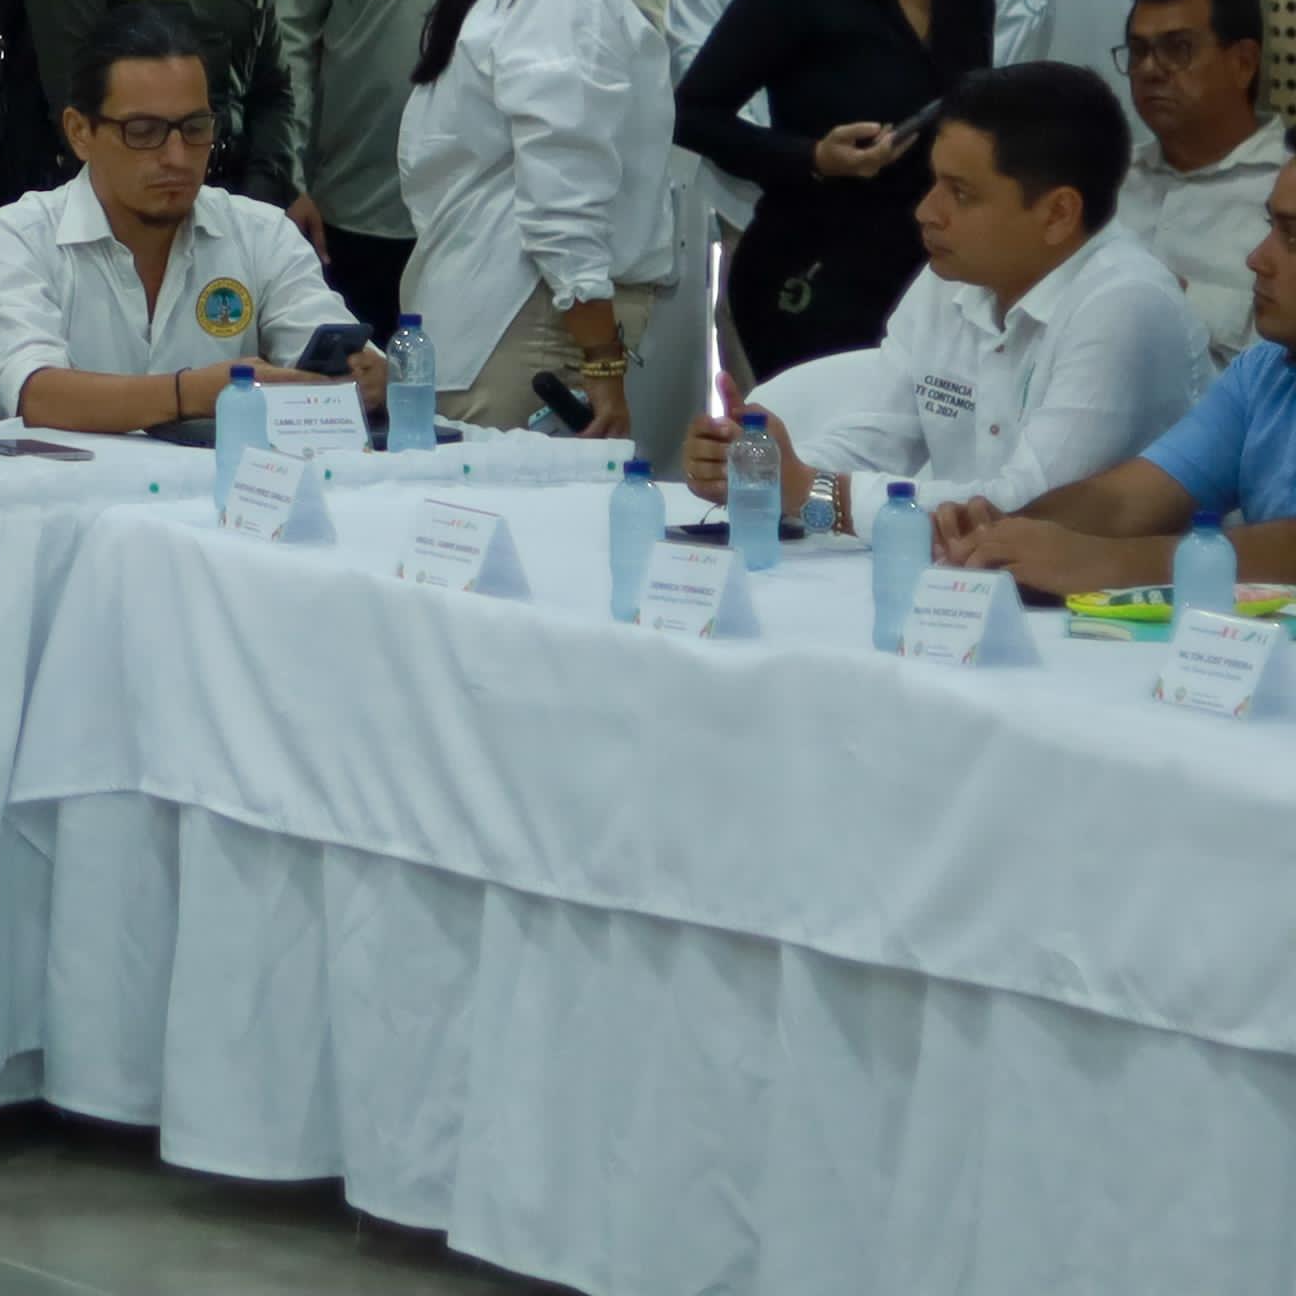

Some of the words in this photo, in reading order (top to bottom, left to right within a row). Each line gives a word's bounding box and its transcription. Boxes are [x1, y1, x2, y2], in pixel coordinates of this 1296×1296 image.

[924, 375, 973, 397] CLEMENCIA
[928, 388, 976, 412] CONTAMOS
[935, 403, 959, 419] 2024
